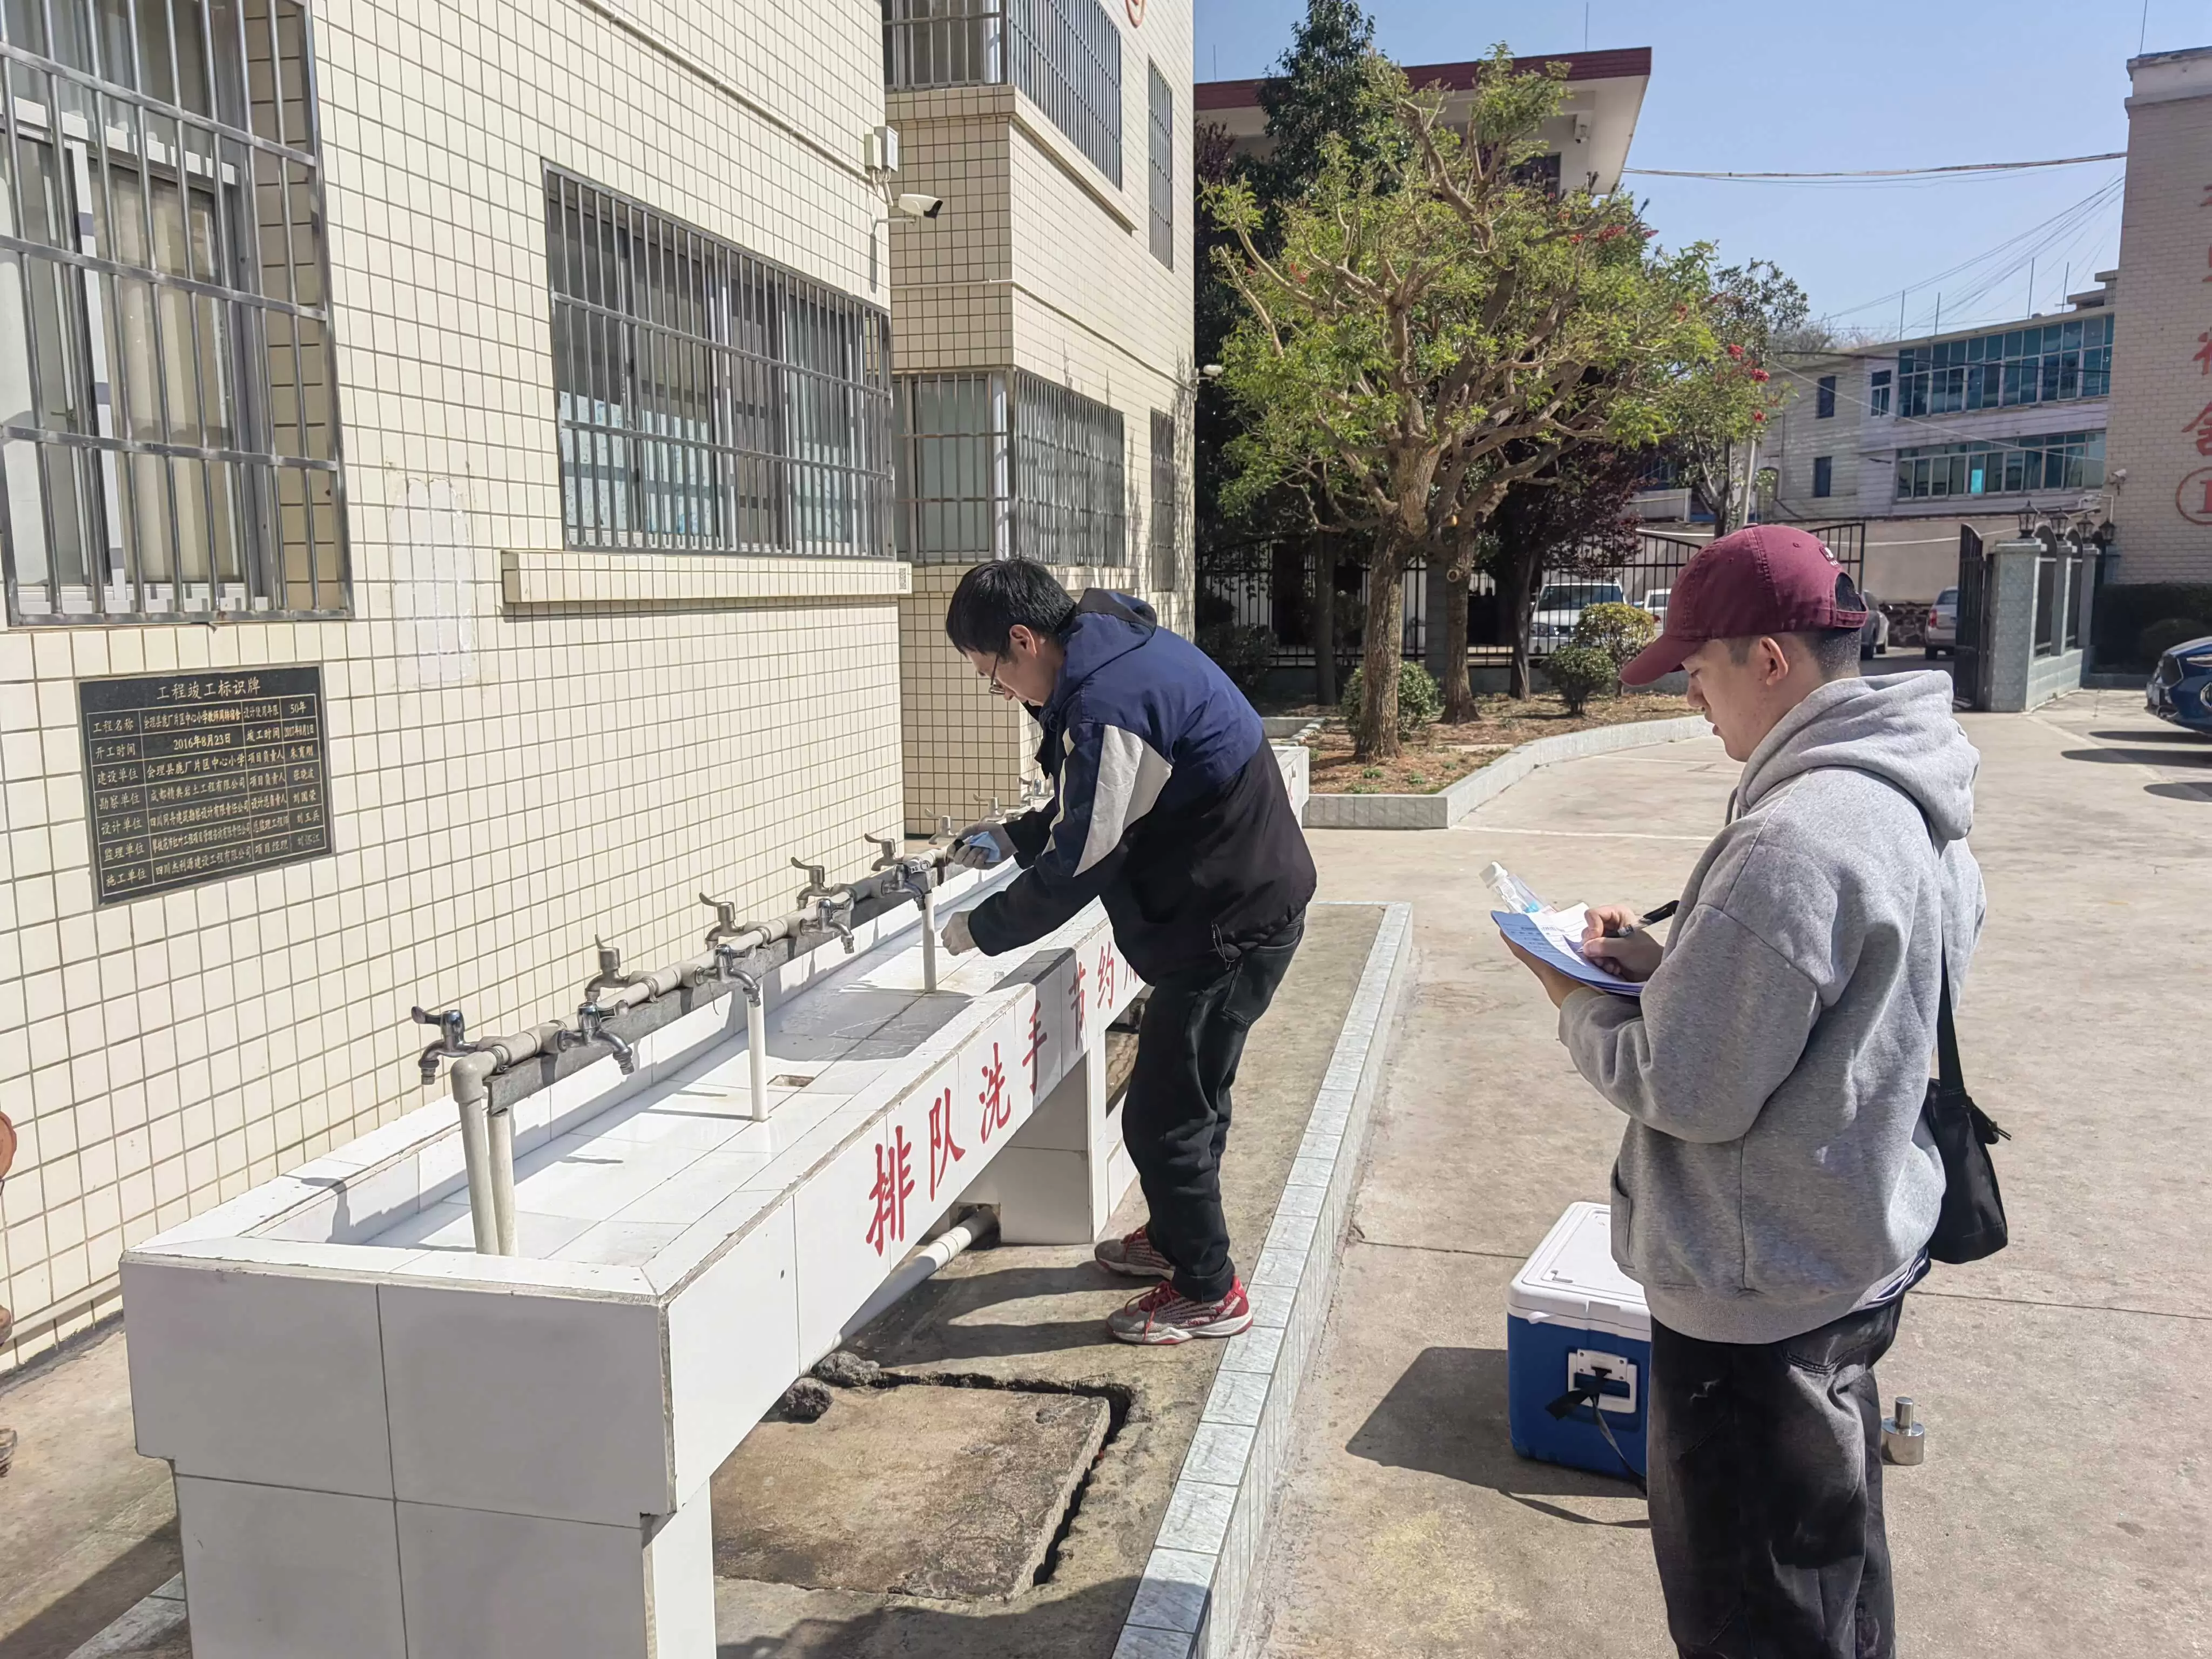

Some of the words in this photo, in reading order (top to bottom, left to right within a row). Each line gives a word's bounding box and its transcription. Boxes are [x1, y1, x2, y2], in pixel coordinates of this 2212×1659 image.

[157, 678, 260, 700] 工程竣工标识牌
[93, 717, 133, 733] 工程名称
[290, 700, 306, 713] 50年
[95, 743, 135, 759] 开工时间
[173, 733, 231, 750] 2016年8月23日
[246, 727, 281, 741] 竣工时间
[97, 767, 138, 785] 建设单位
[146, 752, 244, 778] 会理县鹿厂片区中心小学
[247, 748, 284, 763] 项目负责人
[98, 792, 140, 810] 勘察单位
[249, 772, 285, 786] 项目负责人
[100, 817, 142, 835] 设计单位
[104, 842, 145, 861] 监理单位
[106, 868, 146, 887] 施工单位
[254, 839, 288, 854] 项目经理
